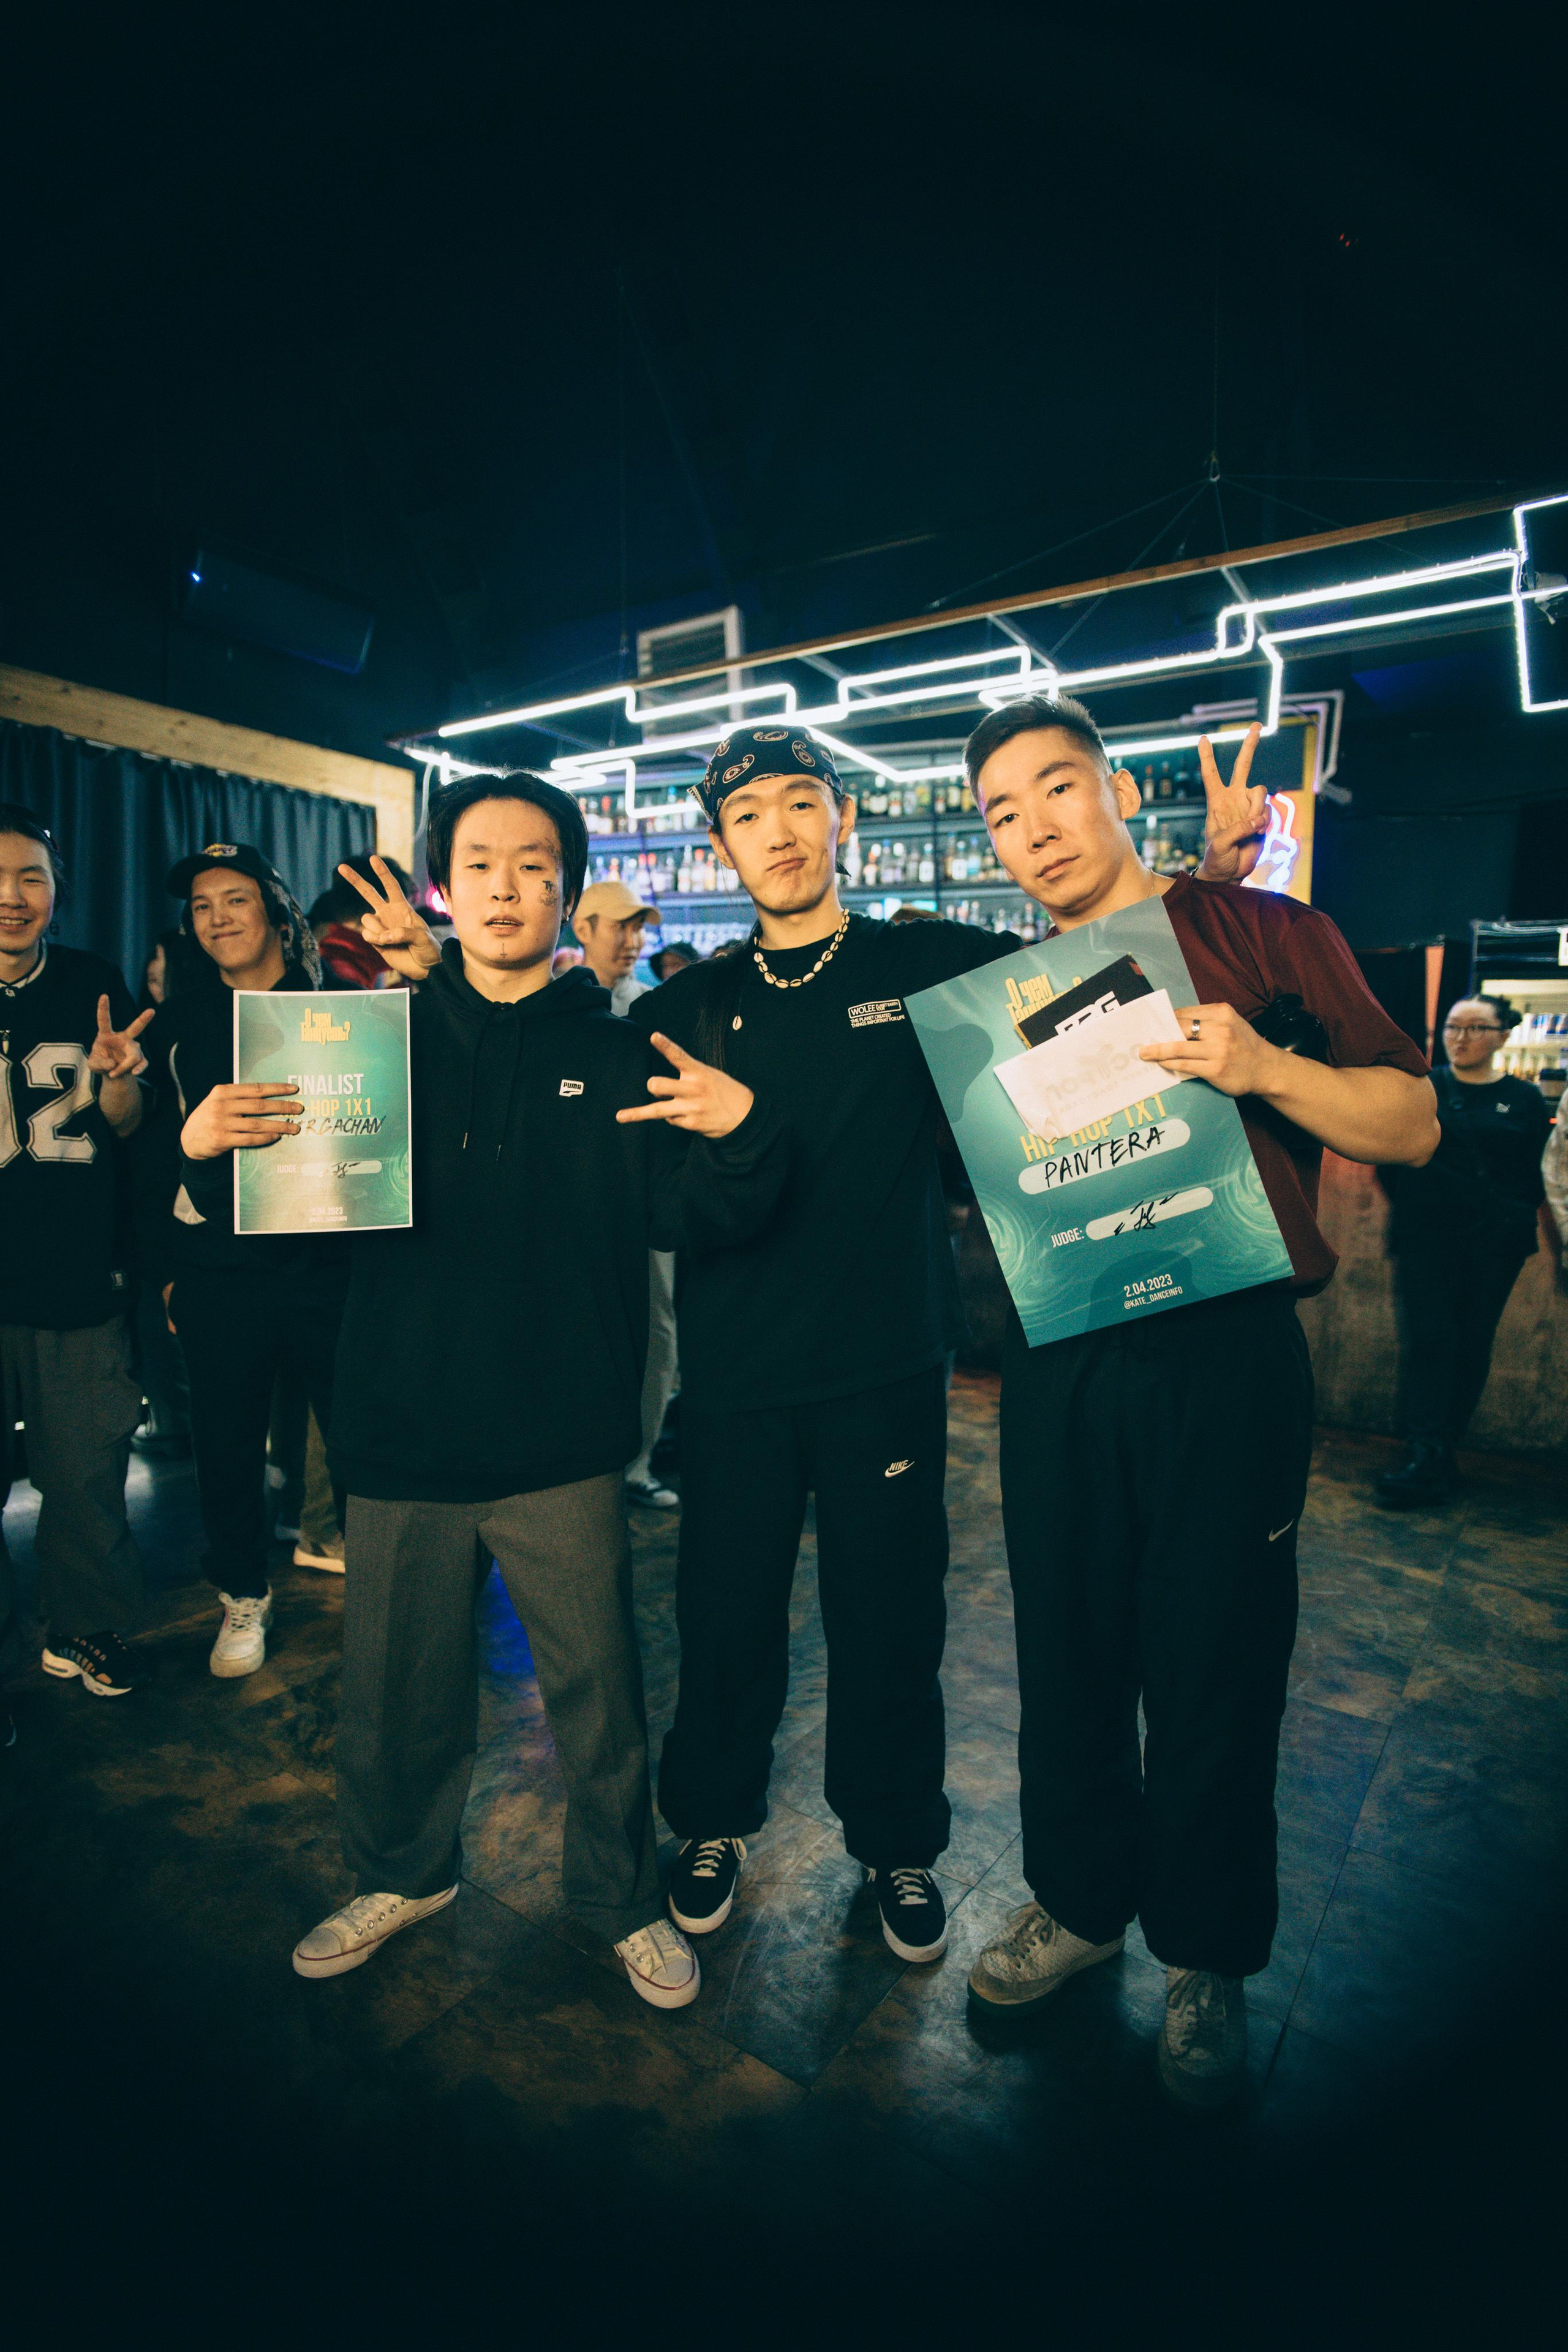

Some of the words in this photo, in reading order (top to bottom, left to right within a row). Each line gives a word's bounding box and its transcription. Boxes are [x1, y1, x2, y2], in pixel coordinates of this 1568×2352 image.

[851, 1005, 876, 1016] WOLEE
[563, 1082, 581, 1090] PUMA
[345, 1098, 371, 1116] 1X1
[1045, 1126, 1166, 1188] PANTERA
[1050, 1227, 1085, 1248] JUDGE:
[1123, 1273, 1173, 1298] 2.04.2023
[1123, 1286, 1183, 1310] @KATE_DANCEINFO
[889, 1460, 908, 1471] NIKE
